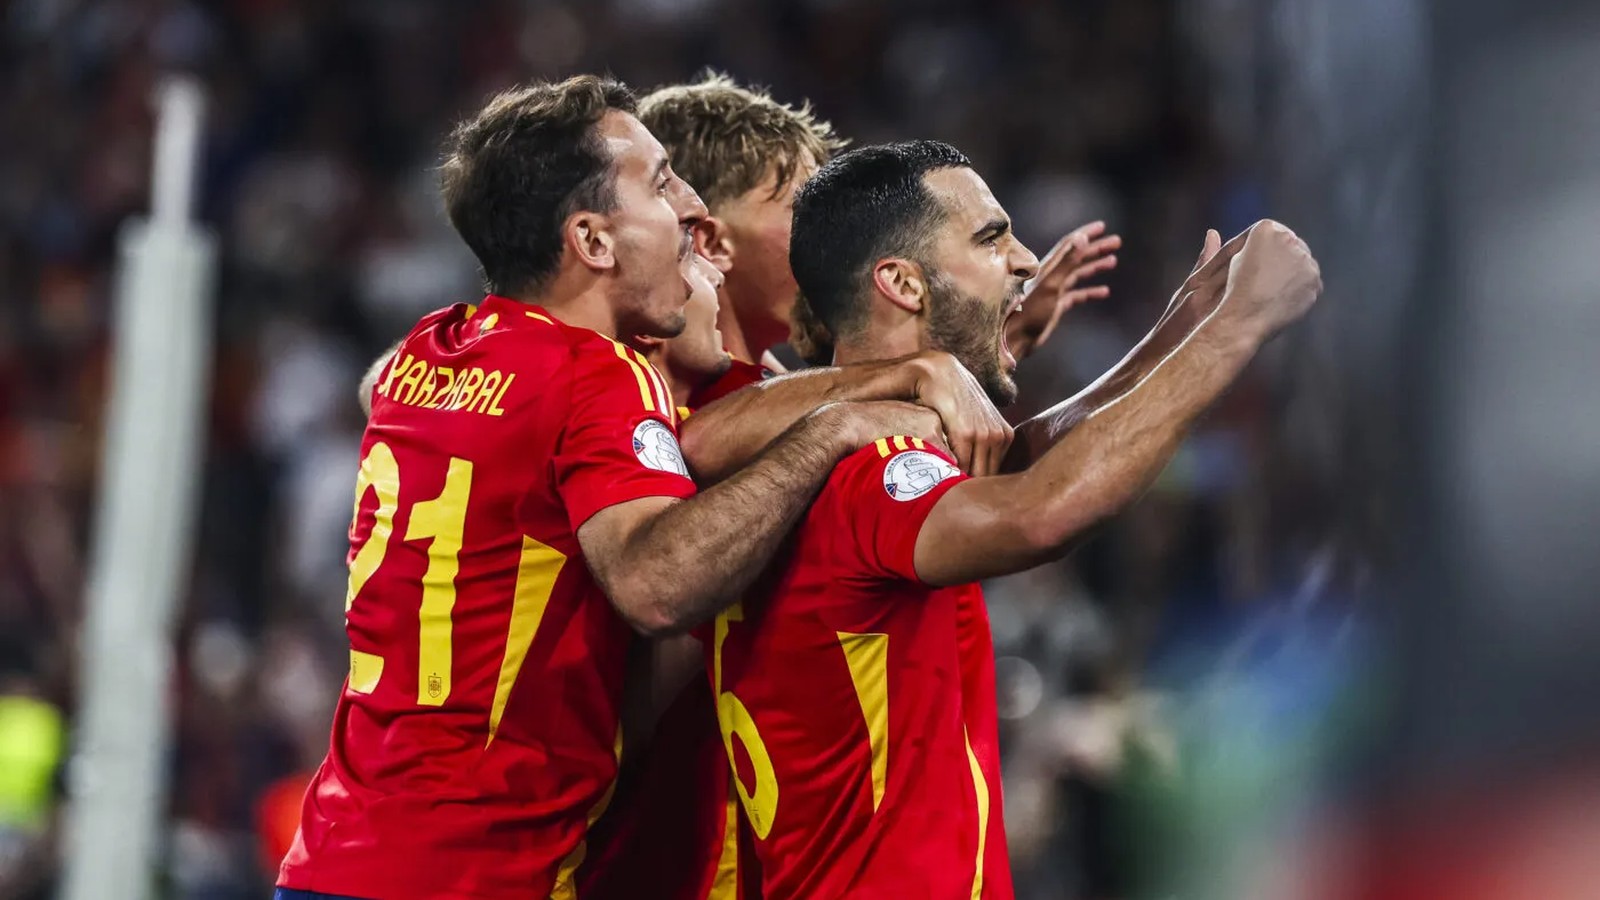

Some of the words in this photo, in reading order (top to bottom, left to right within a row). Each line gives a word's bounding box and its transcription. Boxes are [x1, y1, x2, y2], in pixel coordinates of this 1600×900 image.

[377, 351, 517, 416] YARZABAL
[345, 441, 473, 706] 21
[714, 602, 779, 840] 6
